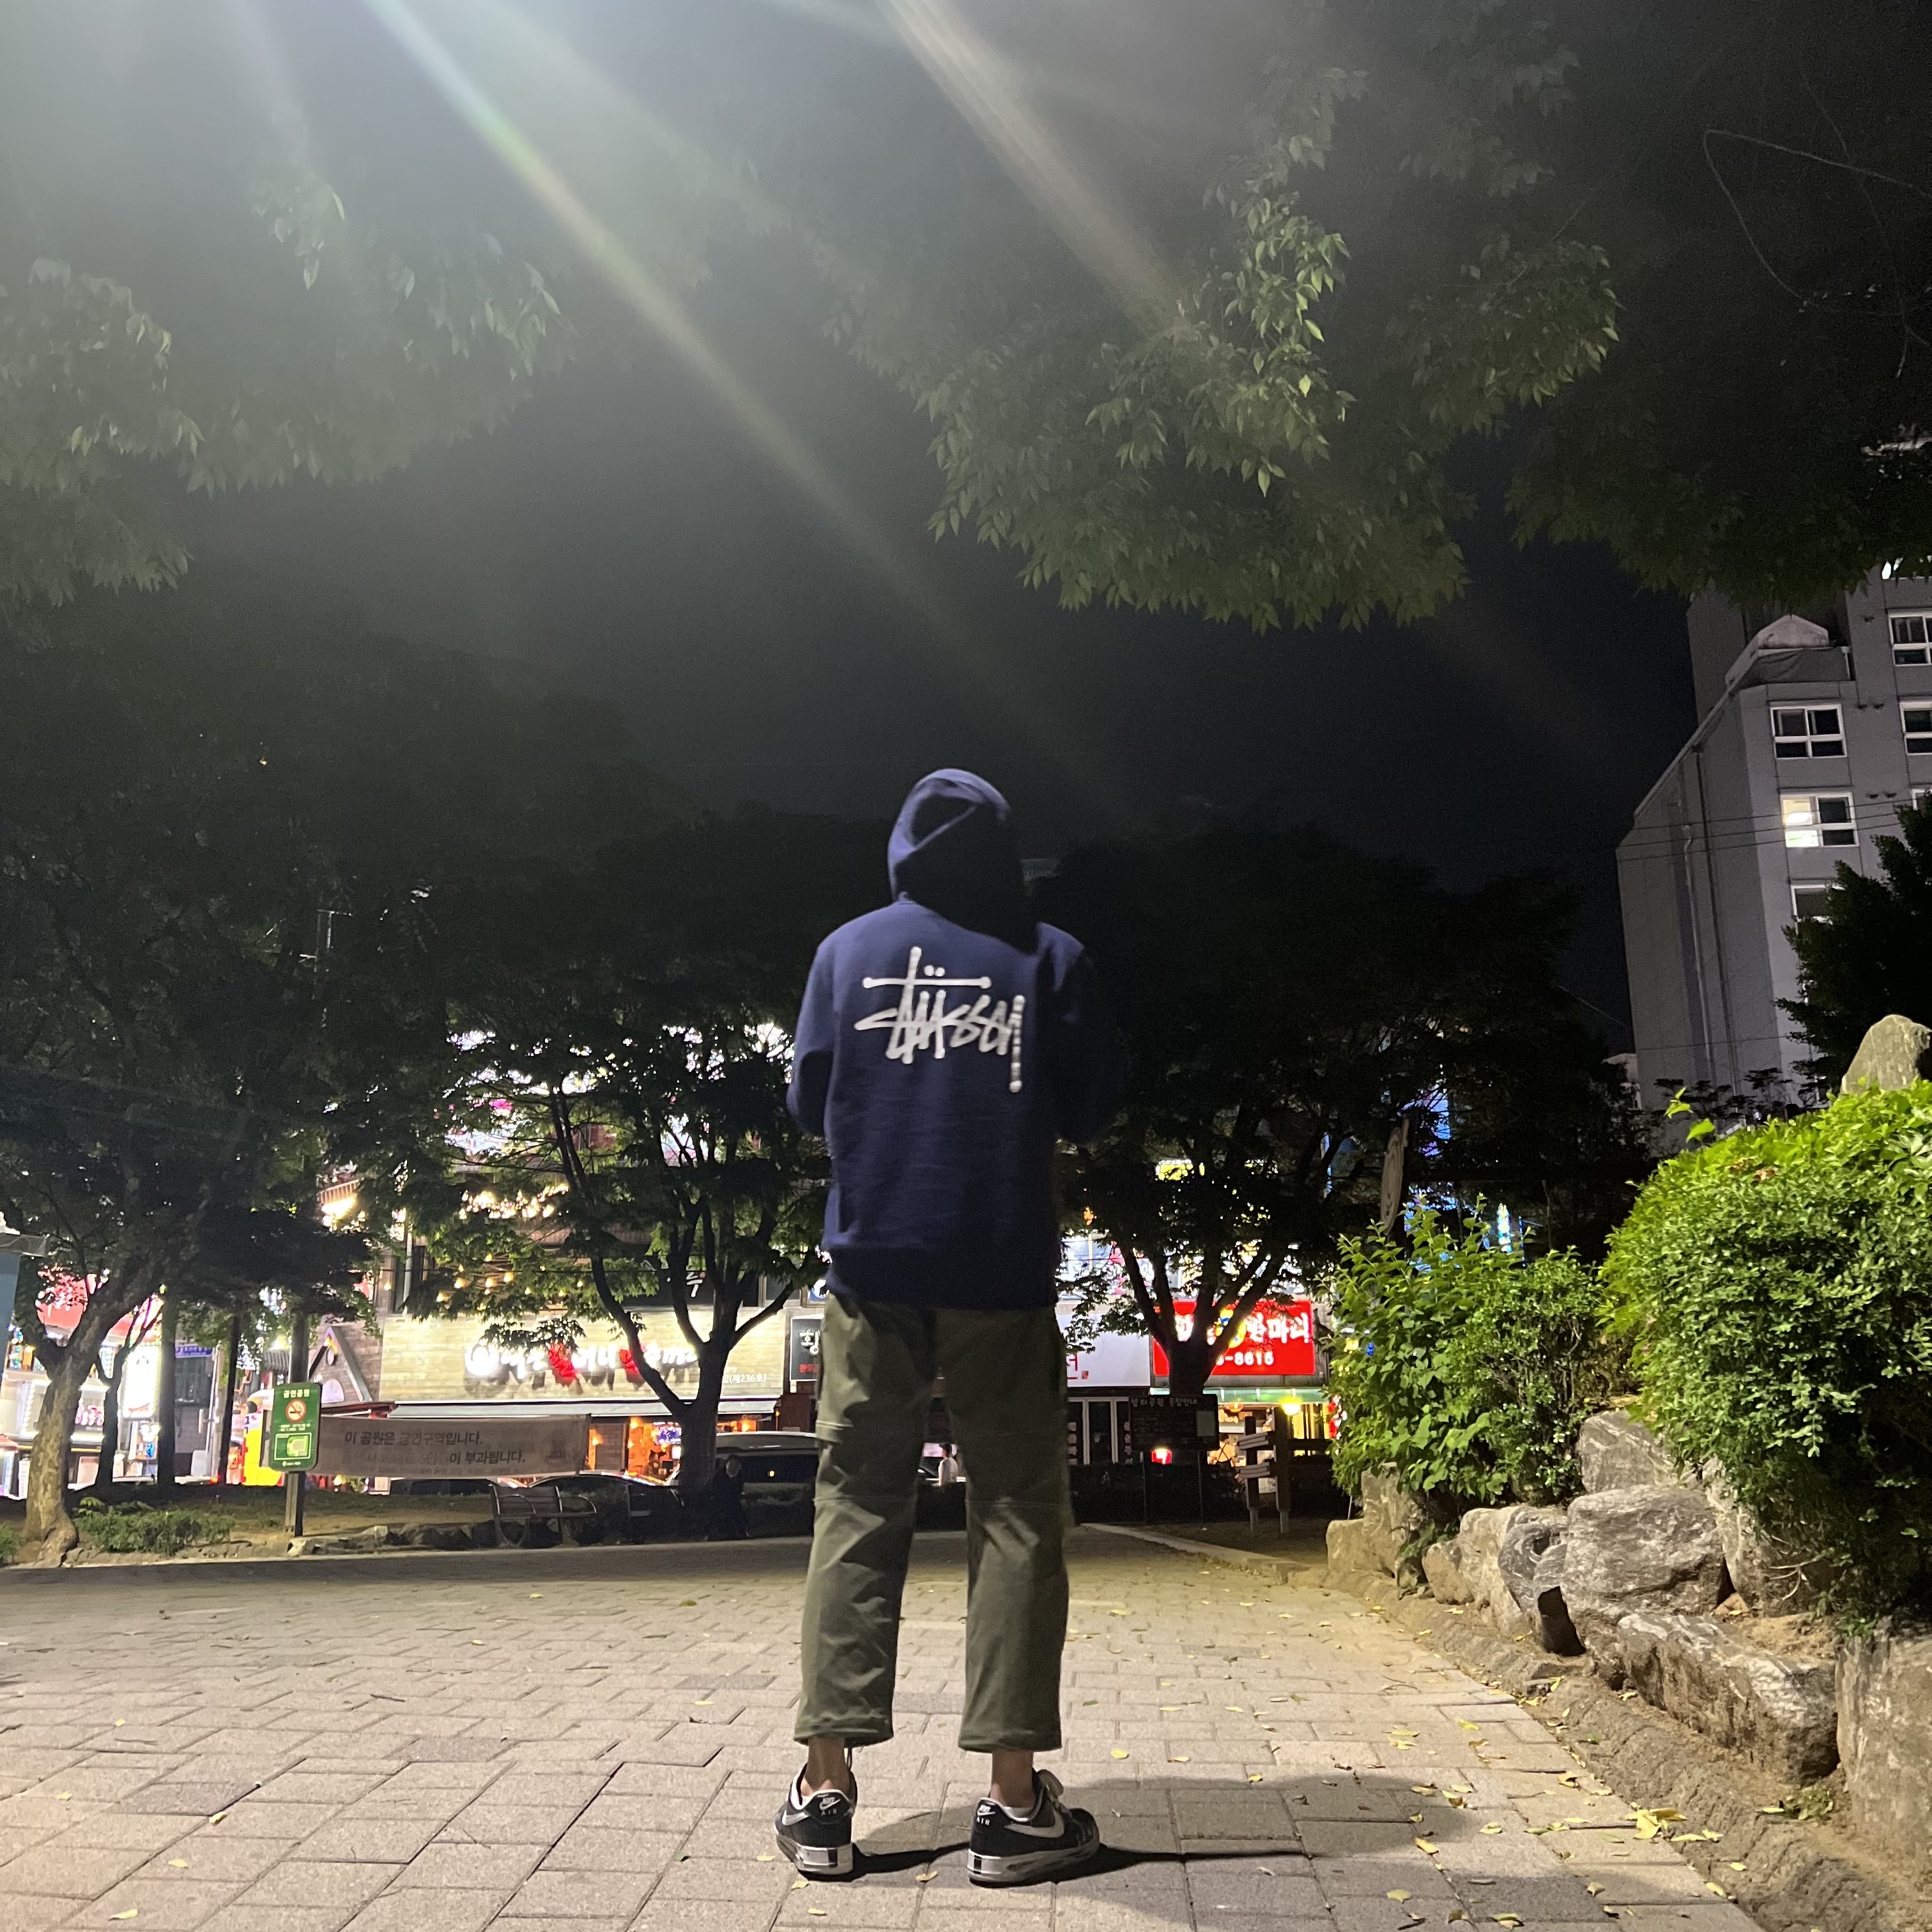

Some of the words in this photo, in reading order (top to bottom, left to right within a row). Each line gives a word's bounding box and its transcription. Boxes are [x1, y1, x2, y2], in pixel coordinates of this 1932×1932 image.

[283, 1388, 310, 1398] 금연공원
[345, 1430, 356, 1445] 이
[360, 1431, 395, 1445] 공원은
[465, 1449, 525, 1465] 부과됩니다.
[976, 1816, 990, 1826] AIR
